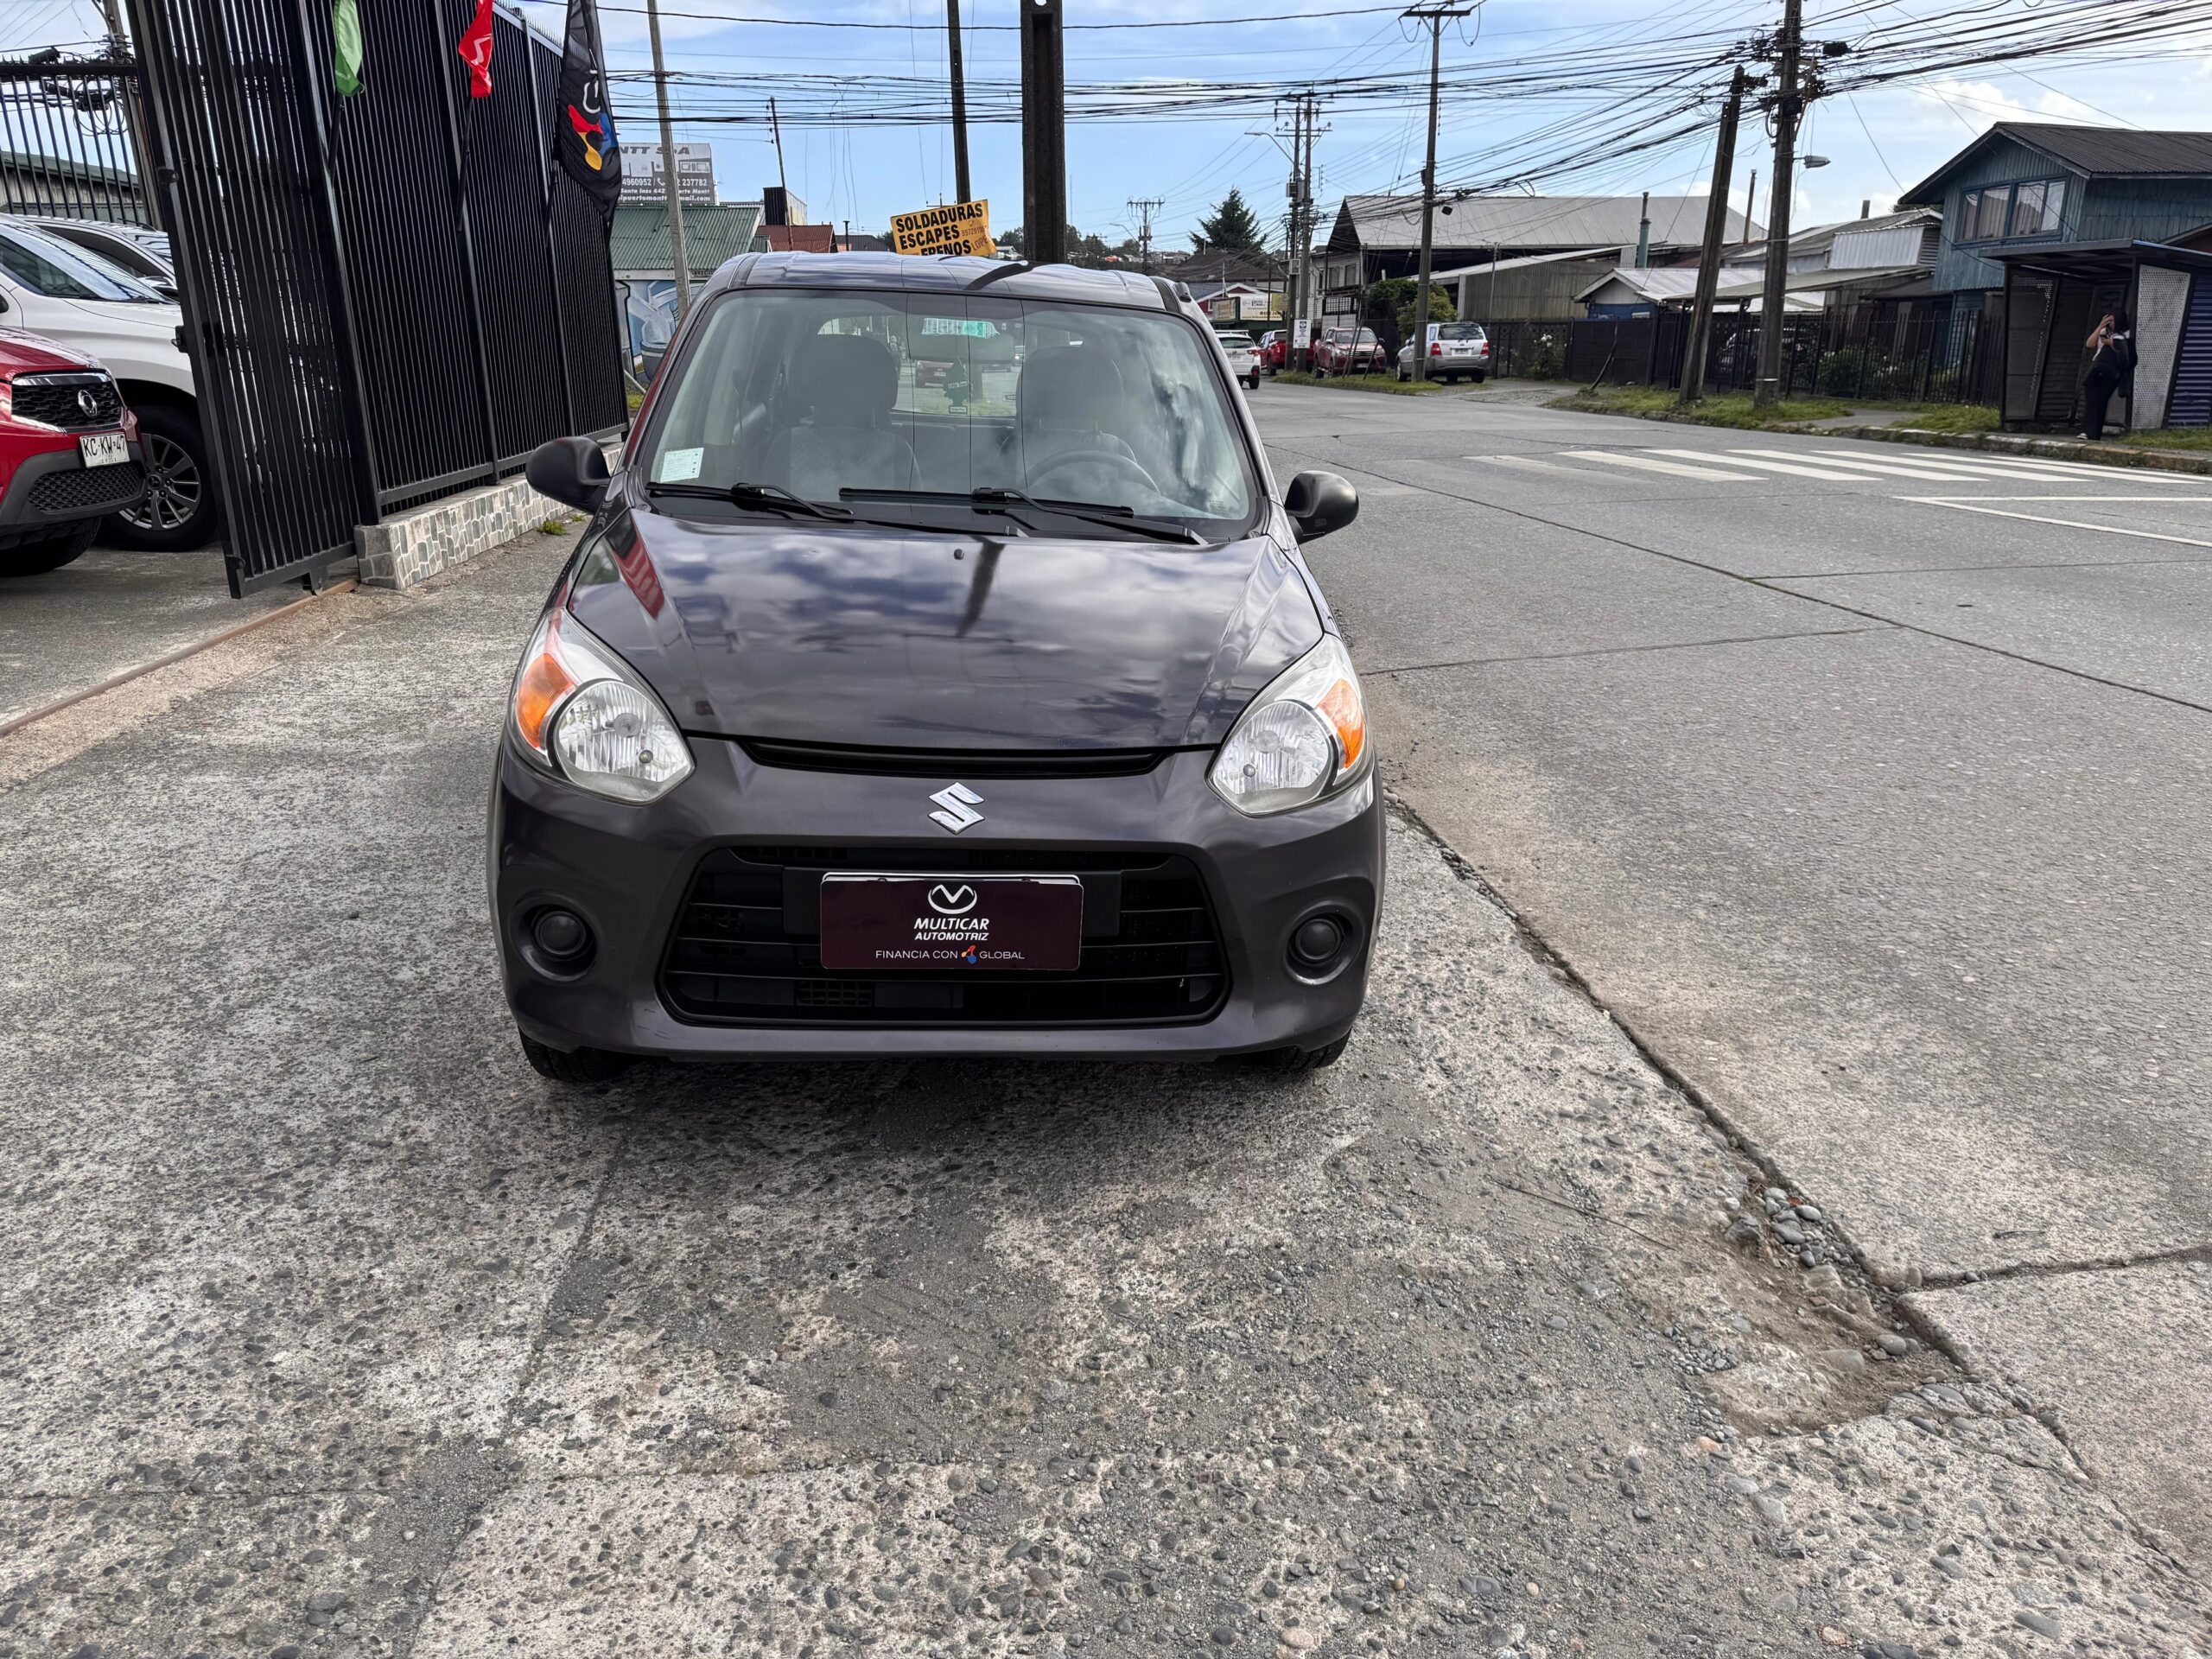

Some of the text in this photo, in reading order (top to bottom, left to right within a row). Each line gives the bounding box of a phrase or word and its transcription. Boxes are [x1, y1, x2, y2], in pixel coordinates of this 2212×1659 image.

[655, 146, 690, 155] SA
[682, 178, 708, 187] 237782
[895, 203, 983, 232] SOLDADURAS
[899, 224, 960, 250] ESCAPES
[913, 918, 989, 931] MULTICAR
[914, 931, 989, 941] AUTOMOTRIZ
[875, 950, 1025, 960] FINANCIA CON GLOBAL
